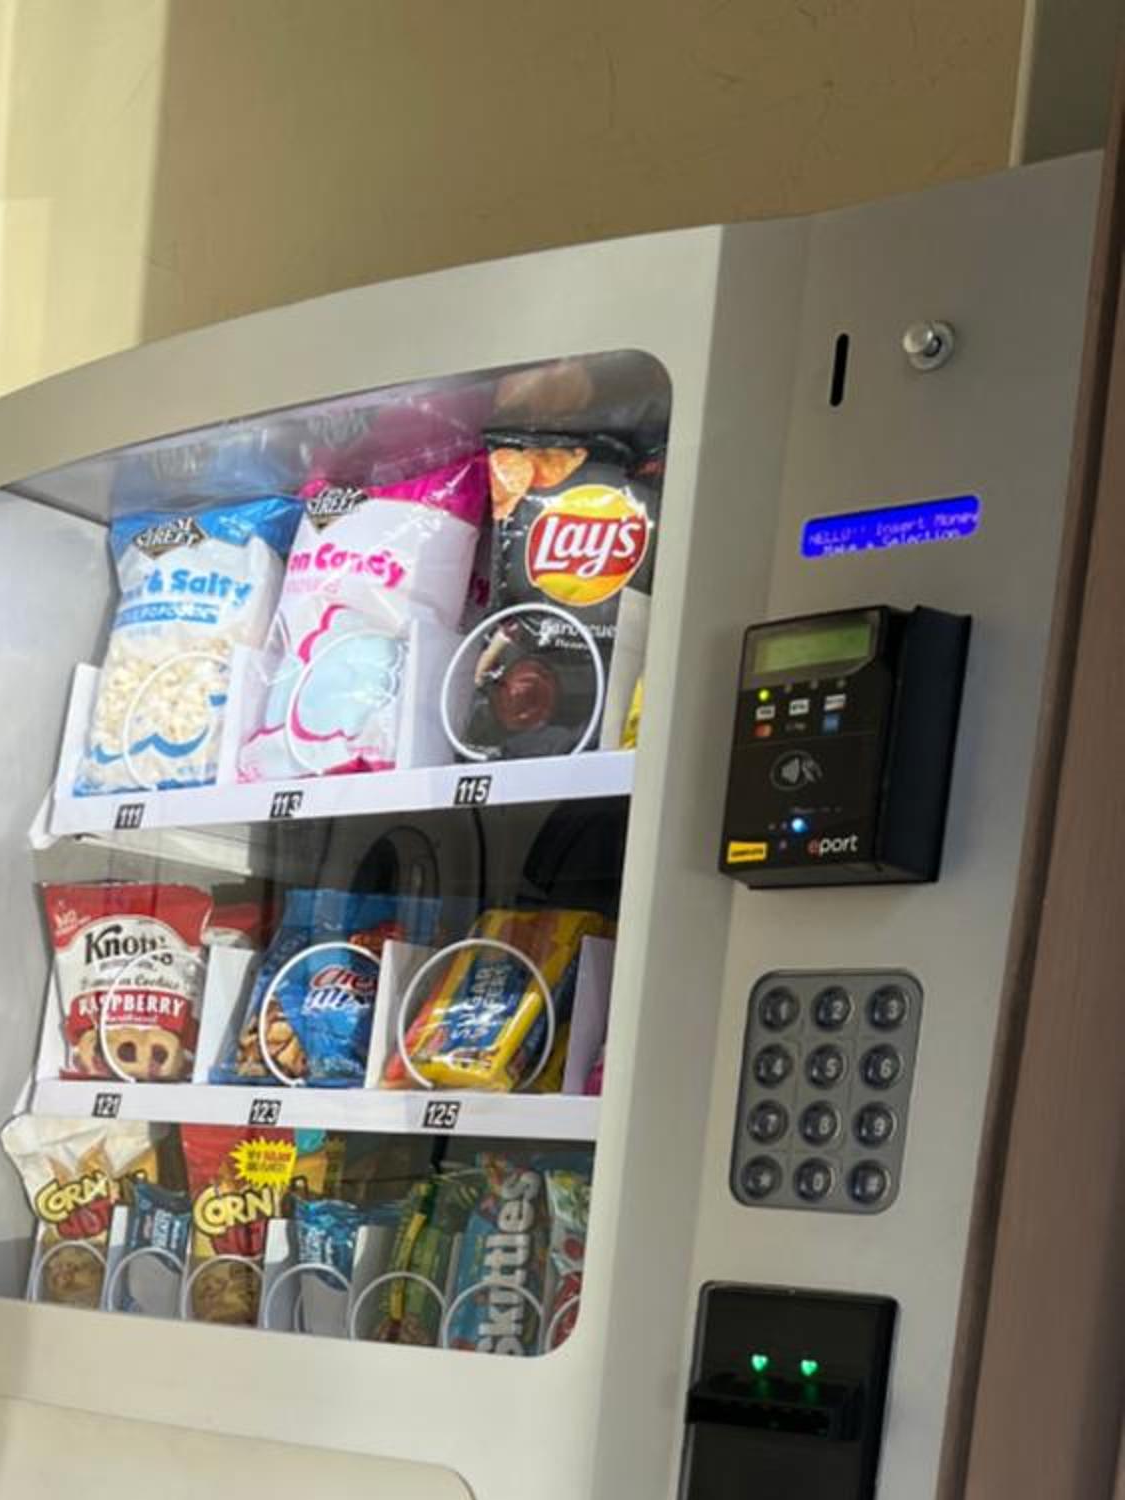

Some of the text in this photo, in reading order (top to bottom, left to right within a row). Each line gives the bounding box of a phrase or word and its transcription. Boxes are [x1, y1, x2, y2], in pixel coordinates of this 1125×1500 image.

[534, 514, 643, 577] Lay's
[457, 779, 489, 803] 115
[119, 806, 142, 828] 111
[831, 1001, 843, 1019] 2
[772, 1058, 892, 1079] 4 5 6
[251, 1102, 279, 1123] 123
[426, 1103, 459, 1127] 125
[767, 1114, 778, 1132] 7
[35, 1172, 111, 1222] CORN
[192, 1185, 275, 1235] CORN
